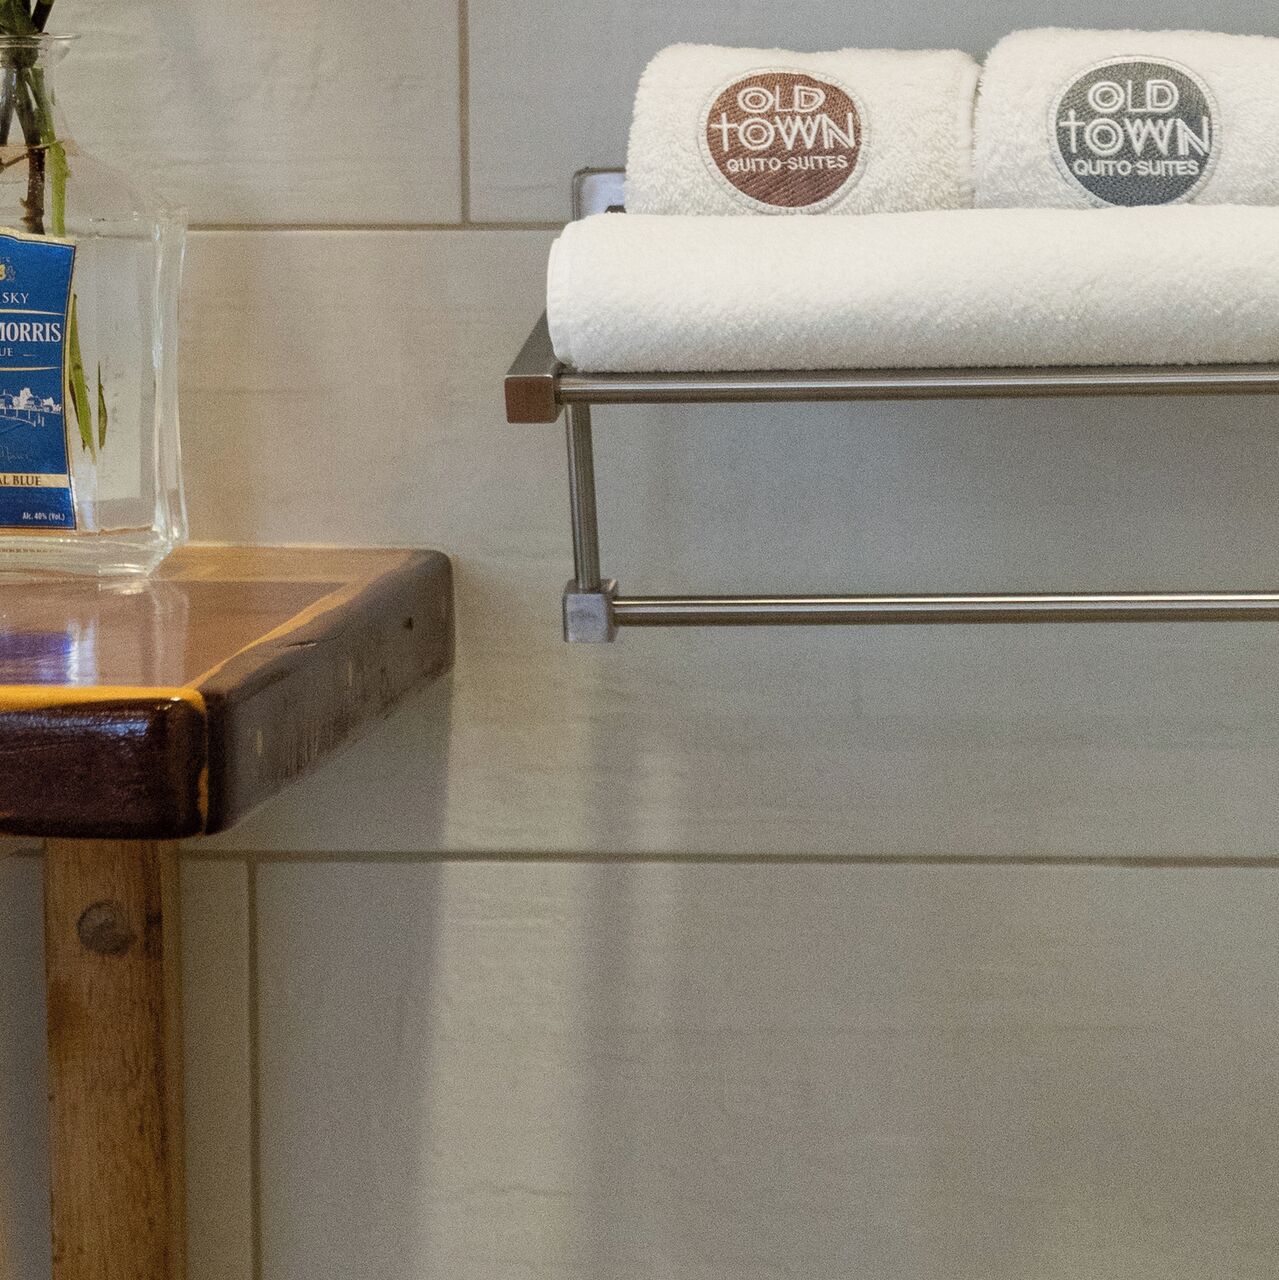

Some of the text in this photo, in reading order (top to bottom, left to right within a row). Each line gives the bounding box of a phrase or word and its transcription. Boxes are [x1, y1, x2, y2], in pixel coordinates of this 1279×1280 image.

[737, 85, 826, 114] OLD
[1088, 80, 1180, 114] OLD
[726, 154, 848, 172] QUITO SUITES
[1074, 159, 1200, 176] QUITO SUITES
[13, 475, 41, 486] BLUE
[23, 512, 65, 521] Alc. 40% (Vol.)
